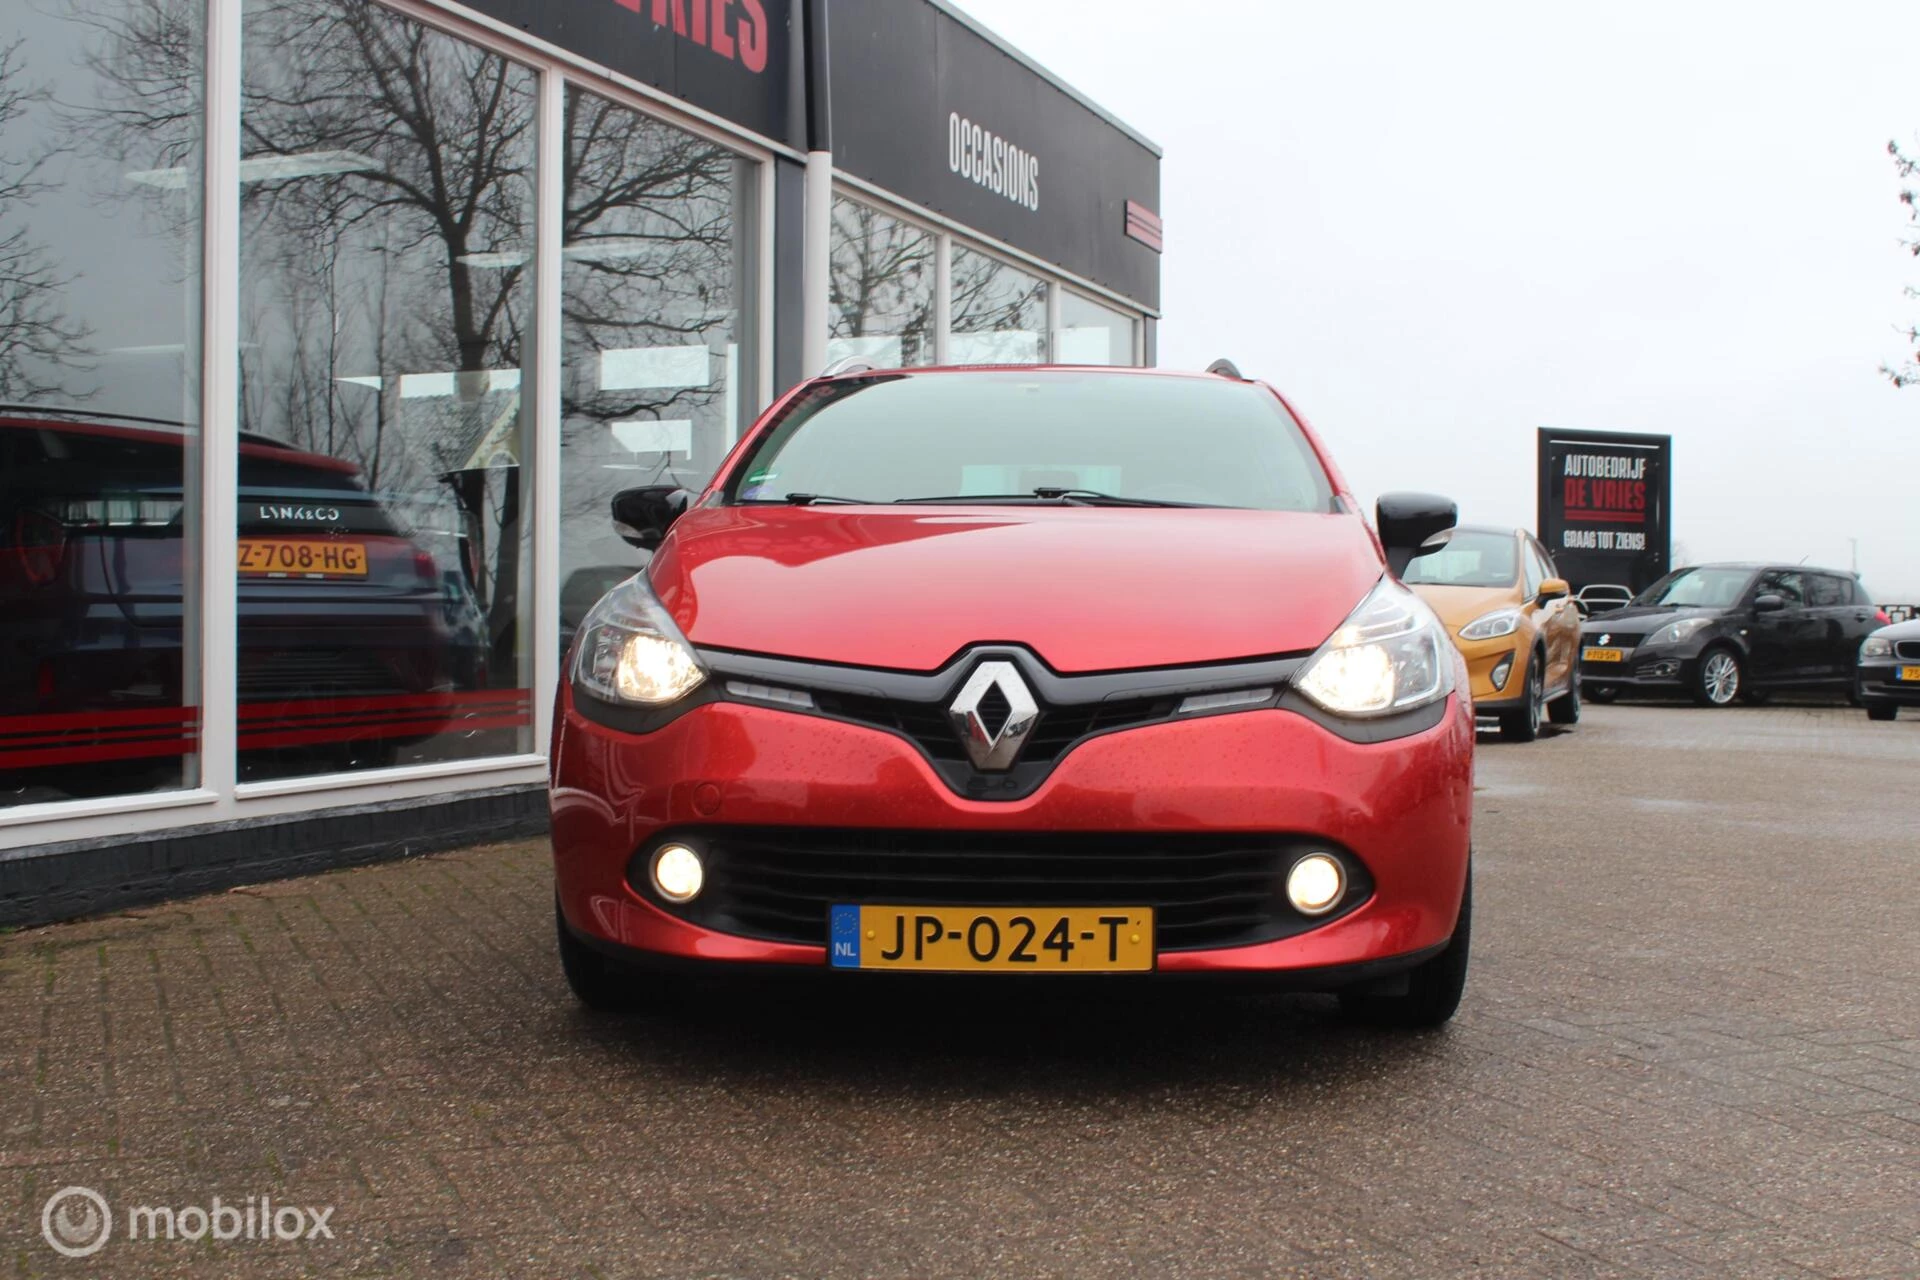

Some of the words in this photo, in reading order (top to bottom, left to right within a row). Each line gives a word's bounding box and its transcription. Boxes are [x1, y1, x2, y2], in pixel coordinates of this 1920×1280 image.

[949, 112, 1039, 211] OCCASIONS
[1564, 454, 1646, 479] AUTOBEDRIJF
[1564, 478, 1587, 507] DE
[1592, 480, 1646, 509] VRIES
[1563, 530, 1596, 548] GRAAG
[1597, 531, 1614, 549] TOT
[1615, 532, 1646, 550] ZIENS!
[239, 544, 357, 569] Z-708-HG
[835, 943, 856, 957] NL
[881, 915, 1128, 962] JP-024-T
